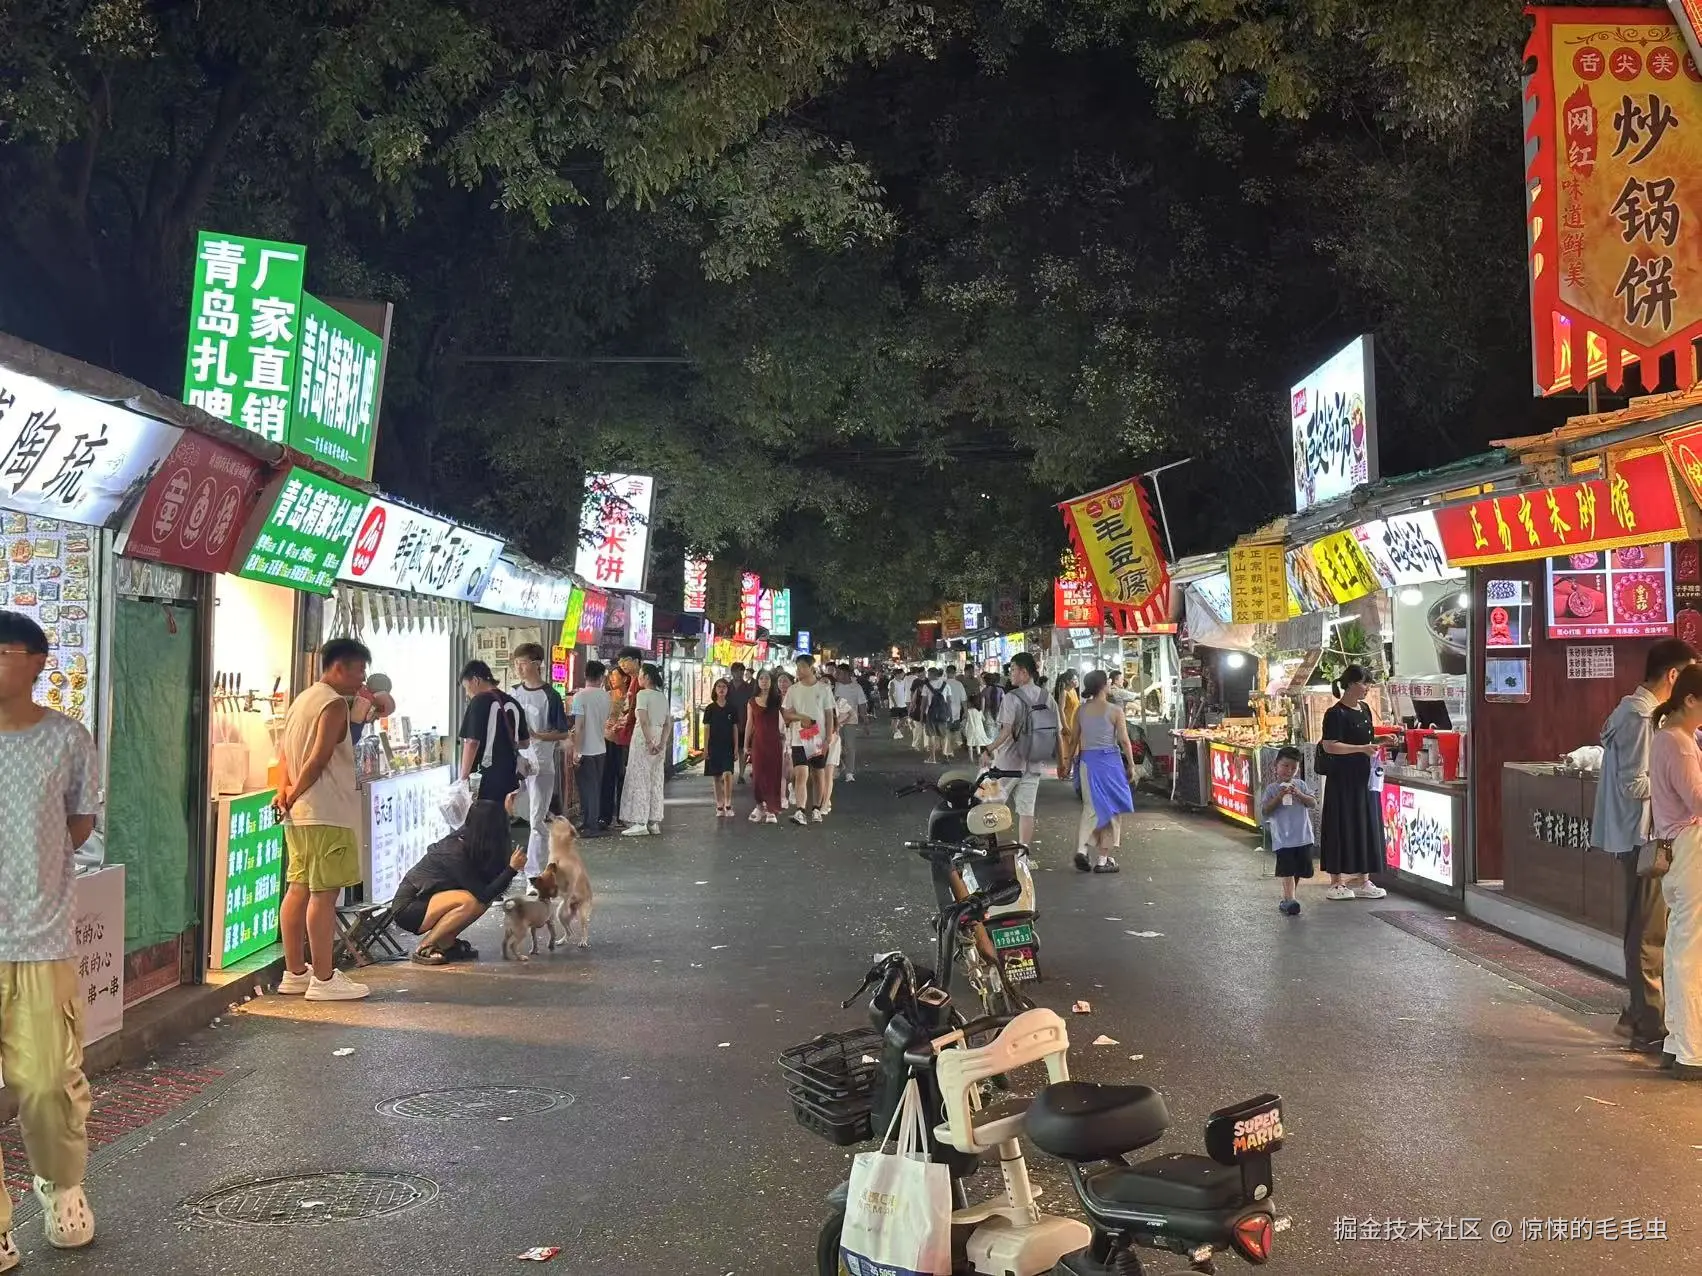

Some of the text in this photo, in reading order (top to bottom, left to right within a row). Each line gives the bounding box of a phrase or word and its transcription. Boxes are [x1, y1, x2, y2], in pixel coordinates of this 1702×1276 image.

[1560, 105, 1595, 288] 网红 味道鲜美
[1611, 94, 1681, 331] 炒锅饼
[188, 240, 246, 424] 青岛扎啤
[241, 249, 300, 442] 厂家直销
[0, 387, 109, 505] 陶琉
[1092, 513, 1151, 602] 毛豆腐
[79, 952, 112, 978] 我的心
[88, 975, 119, 1005] 串一串
[1233, 1124, 1284, 1153] MARIO
[1234, 1108, 1280, 1137] SUPER
